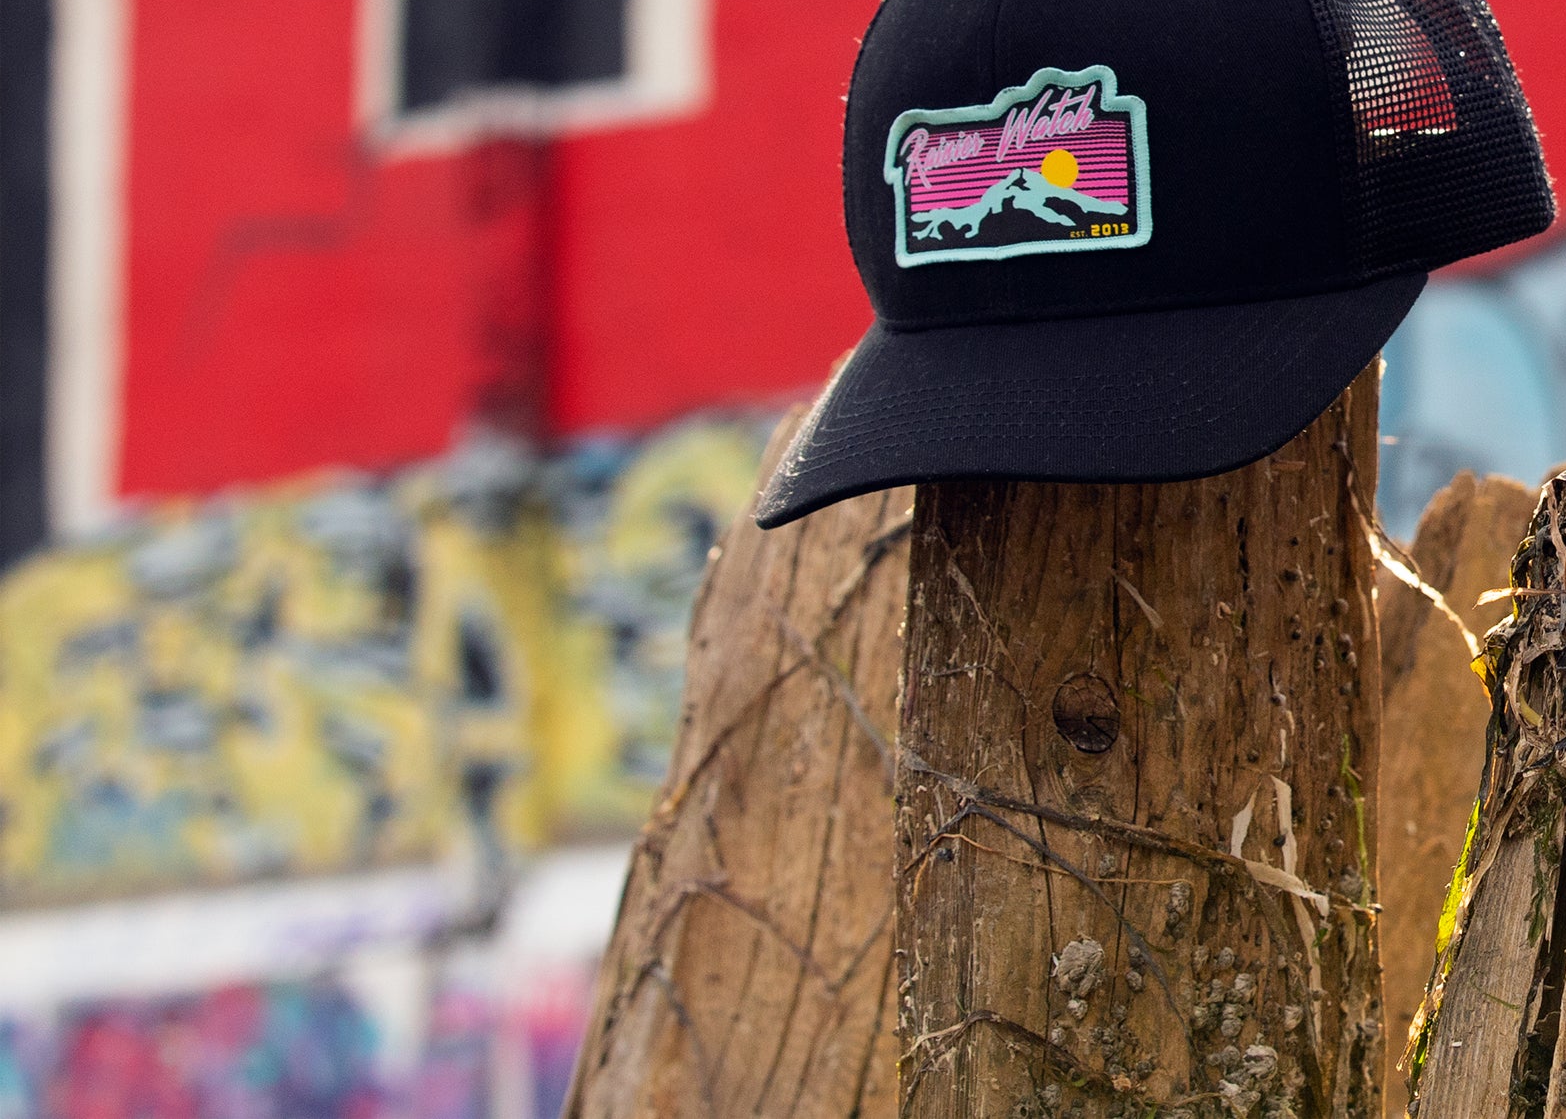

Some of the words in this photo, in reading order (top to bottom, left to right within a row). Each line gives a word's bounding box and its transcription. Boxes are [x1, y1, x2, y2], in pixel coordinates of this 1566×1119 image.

[900, 127, 986, 190] Rainier
[995, 84, 1097, 163] Watch
[1069, 230, 1089, 239] EST.
[1090, 222, 1130, 237] 2013
